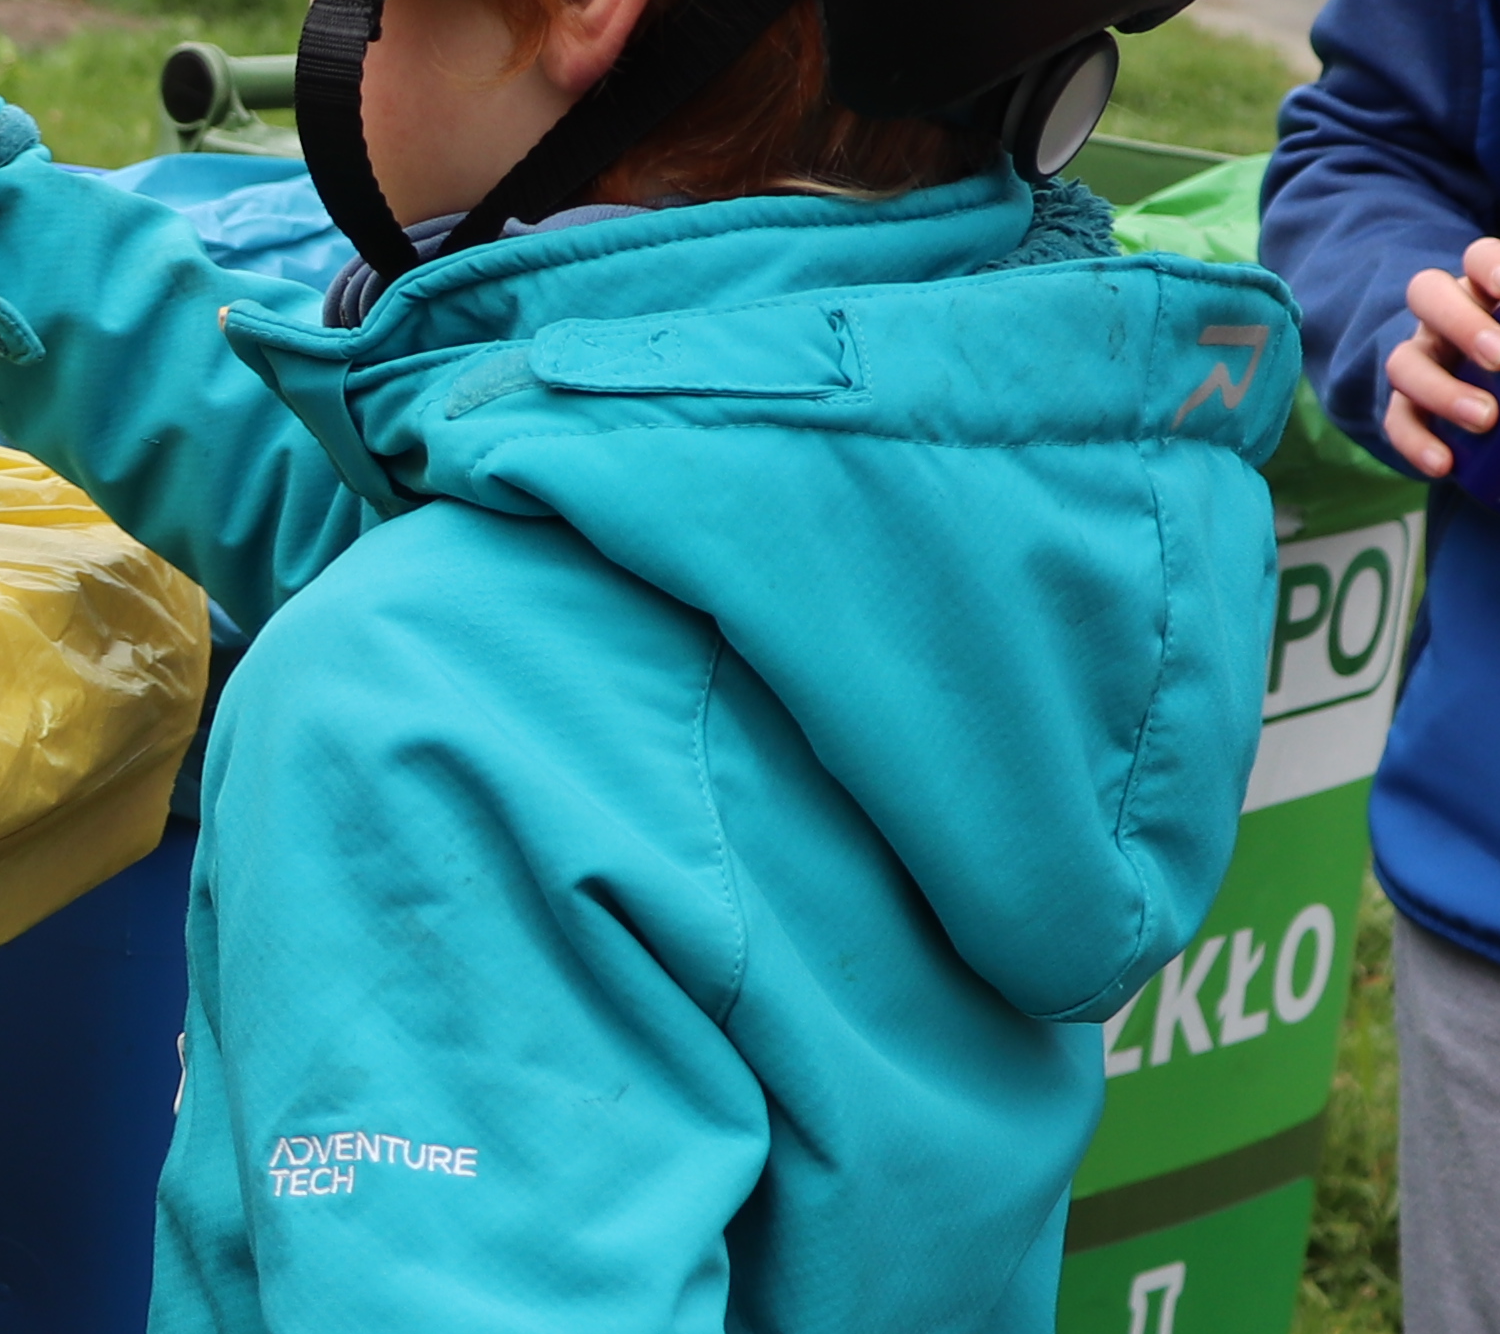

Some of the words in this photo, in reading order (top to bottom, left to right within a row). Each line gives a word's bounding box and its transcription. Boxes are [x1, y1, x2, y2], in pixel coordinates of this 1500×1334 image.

[1268, 546, 1392, 693] PO
[269, 1132, 478, 1176] ADVENTURE
[269, 1166, 354, 1196] TECH
